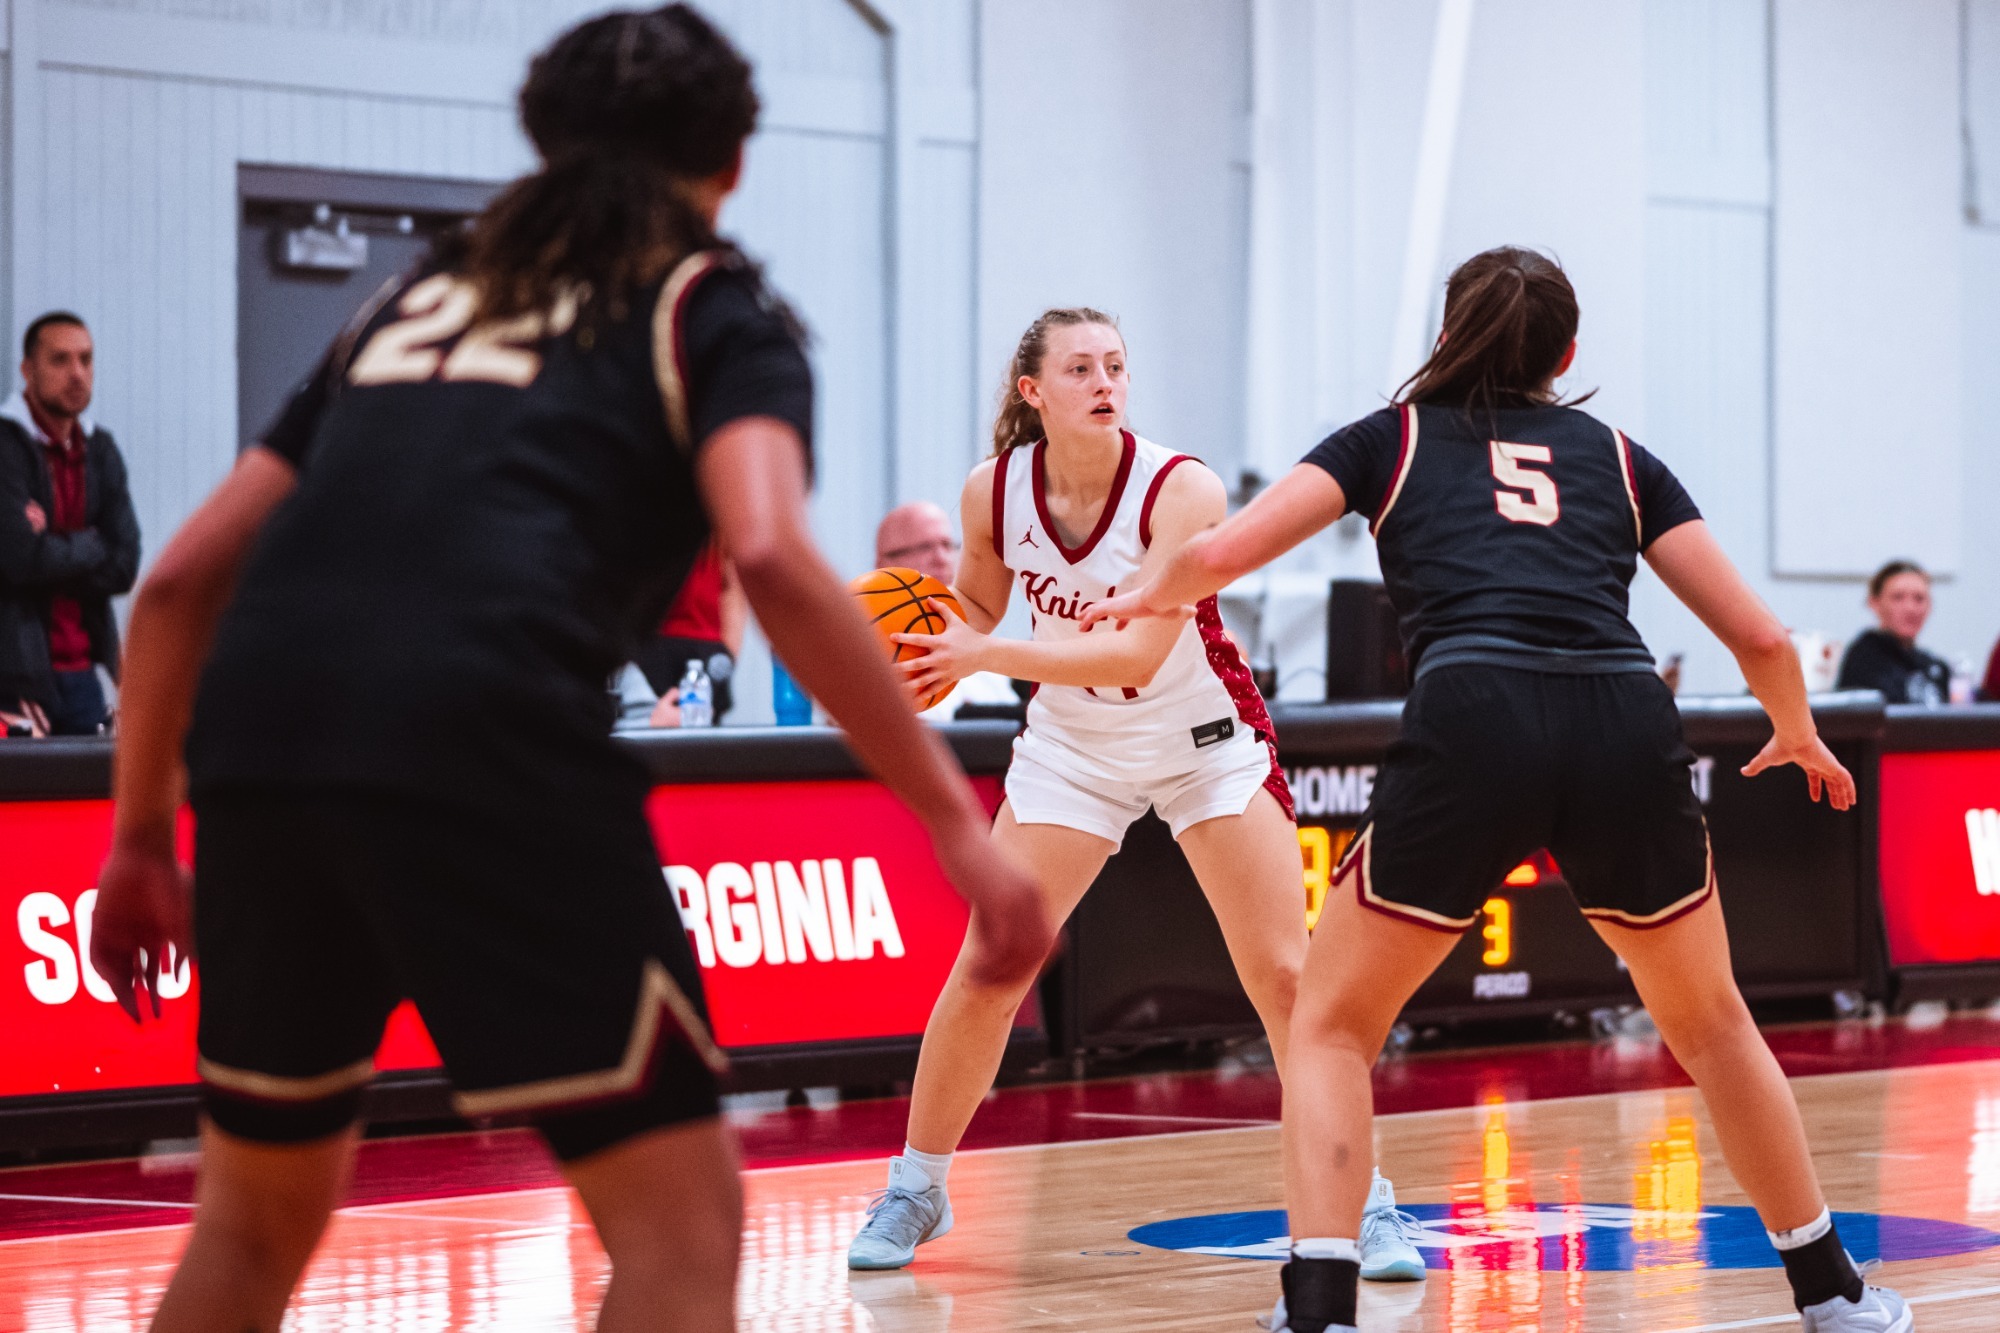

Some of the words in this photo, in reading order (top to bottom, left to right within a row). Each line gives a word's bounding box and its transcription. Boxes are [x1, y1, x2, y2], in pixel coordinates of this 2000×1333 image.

[348, 271, 579, 389] 22
[1488, 440, 1561, 527] 5
[1222, 725, 1230, 734] M
[1284, 765, 1378, 816] HOME
[1482, 898, 1511, 967] 3
